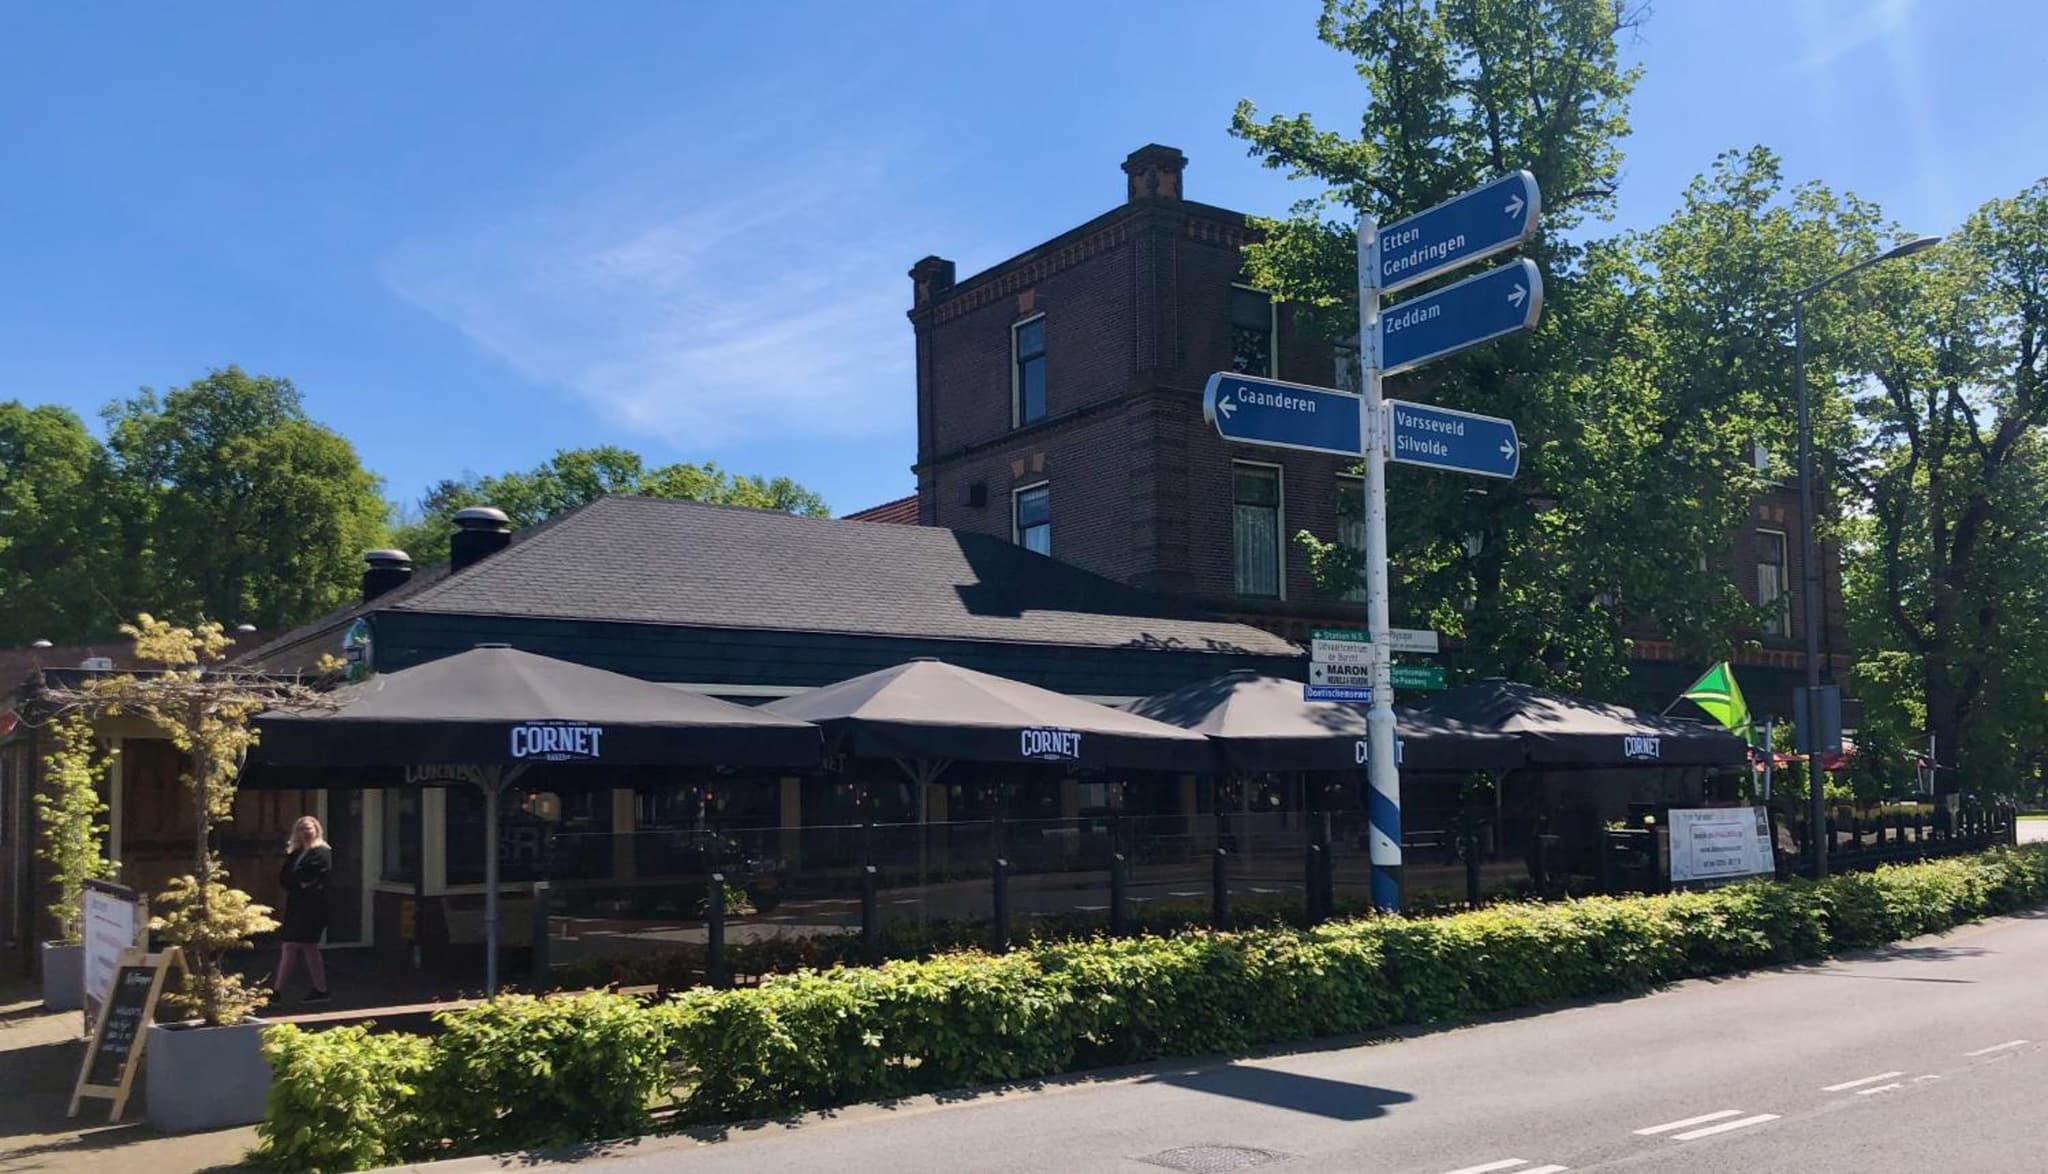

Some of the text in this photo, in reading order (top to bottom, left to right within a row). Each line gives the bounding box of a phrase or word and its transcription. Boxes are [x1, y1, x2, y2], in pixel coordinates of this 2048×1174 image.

[1383, 228, 1420, 252] Etten
[1383, 234, 1465, 276] Gendringen
[1386, 304, 1440, 333] Zeddam
[1238, 387, 1316, 413] Gaanderen
[1397, 411, 1464, 436] Varsseveld
[1397, 434, 1449, 457] Silvolde
[1327, 665, 1368, 676] MARON
[511, 726, 603, 758] CORNET
[1021, 730, 1082, 759] CORNET
[1624, 736, 1661, 758] CORNET
